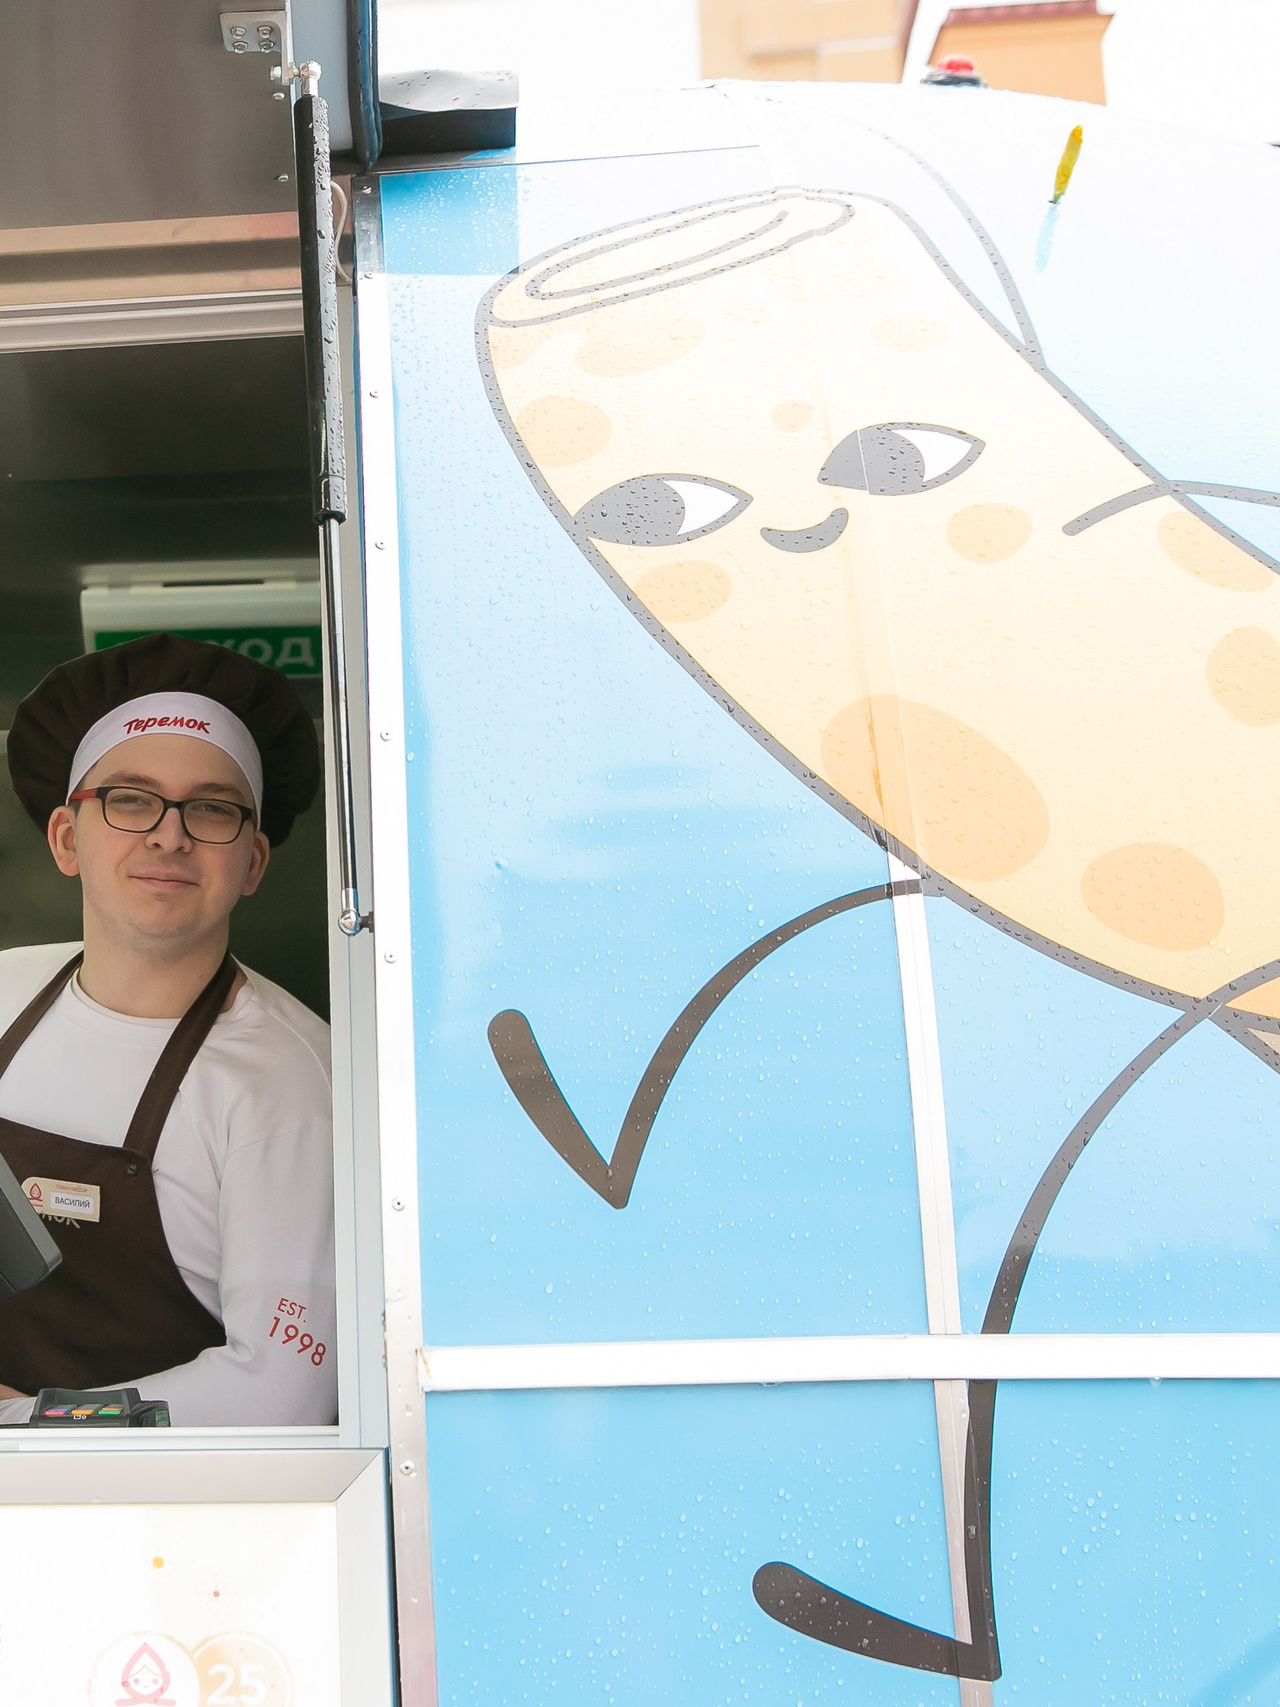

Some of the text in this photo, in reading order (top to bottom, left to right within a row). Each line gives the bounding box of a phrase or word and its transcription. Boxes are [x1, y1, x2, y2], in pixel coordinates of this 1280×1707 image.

[123, 716, 210, 734] Теремок
[55, 1196, 90, 1208] ВАСИЛИЙ
[277, 1297, 307, 1323] EST.
[269, 1316, 326, 1366] 1998
[207, 1663, 267, 1705] 25
